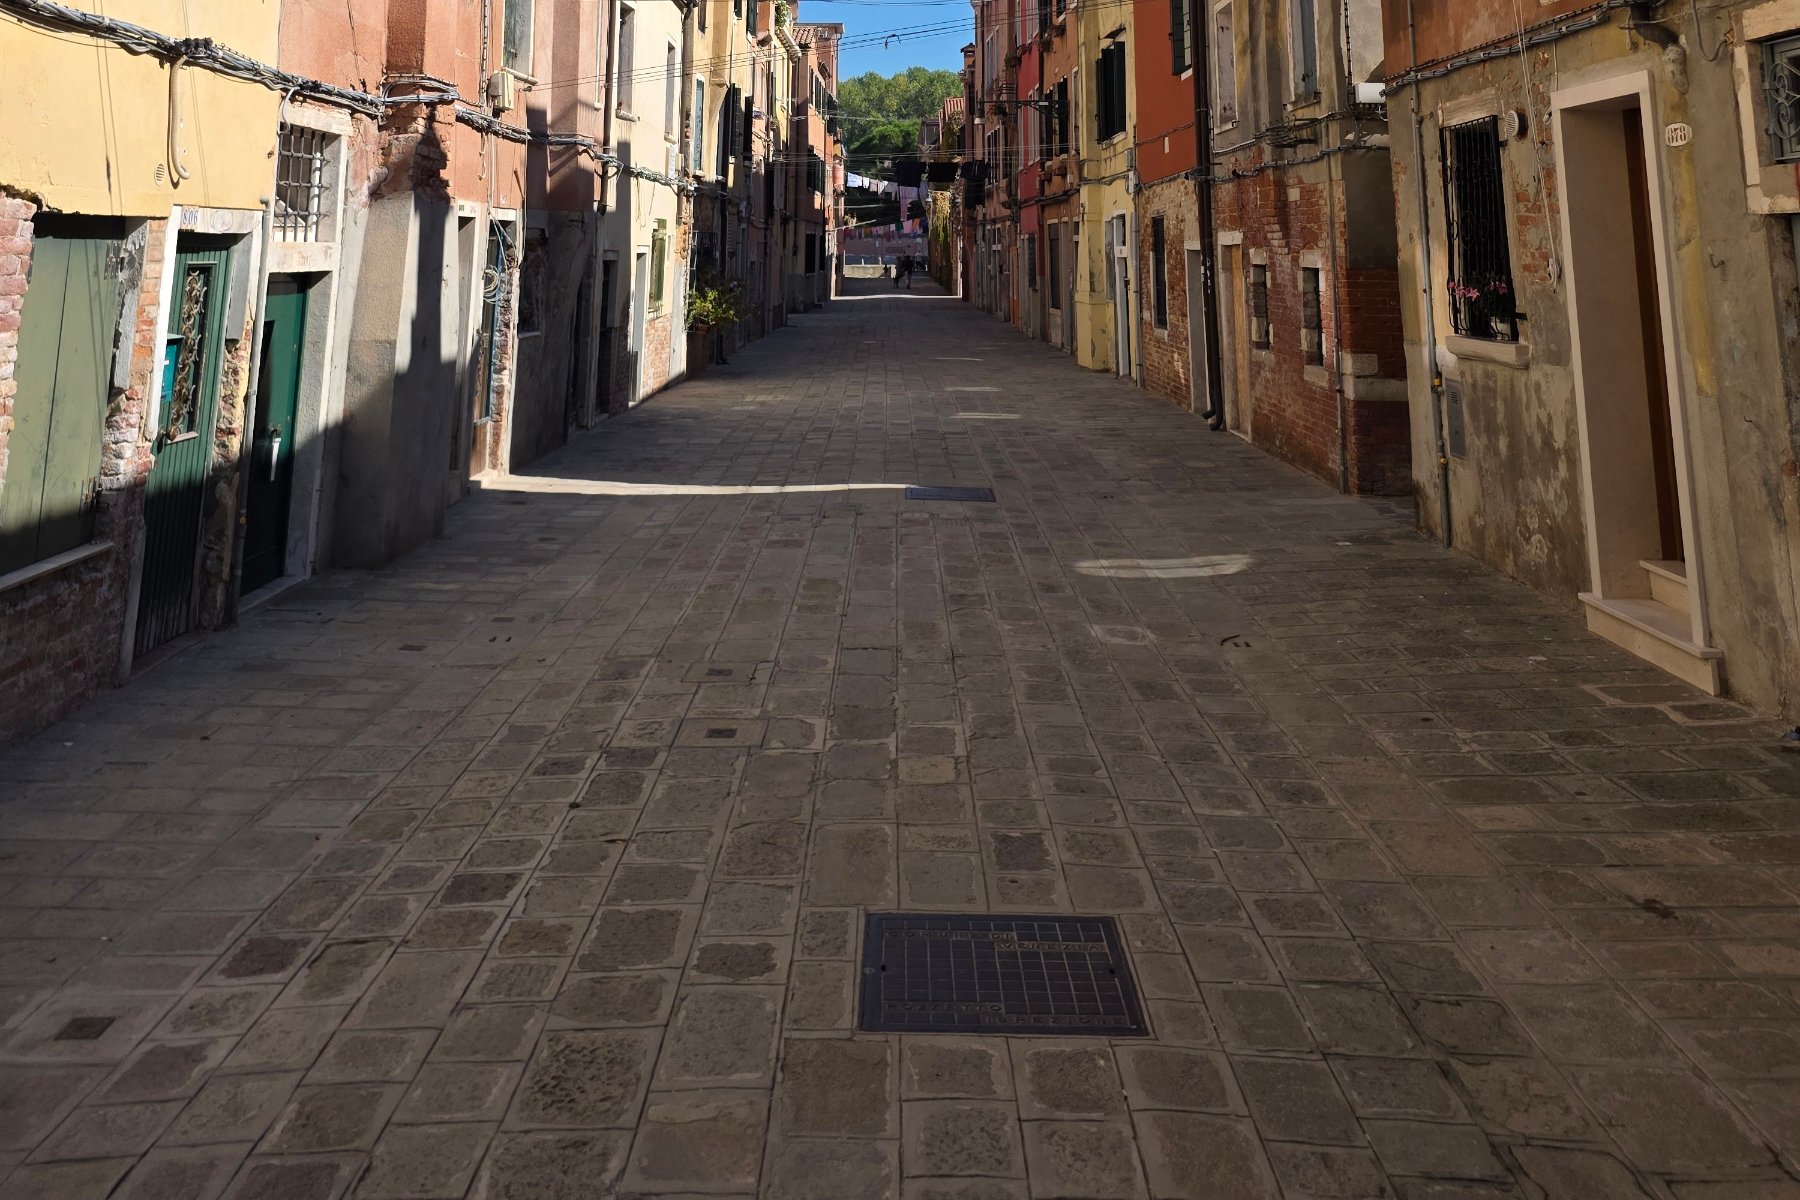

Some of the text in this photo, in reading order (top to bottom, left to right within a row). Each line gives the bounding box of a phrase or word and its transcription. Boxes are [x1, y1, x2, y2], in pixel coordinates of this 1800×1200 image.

[182, 208, 199, 225] 806
[885, 930, 1010, 940] COMUNE DI
[1001, 942, 1101, 951] VENEZIA
[886, 1002, 1002, 1011] POZZETTO
